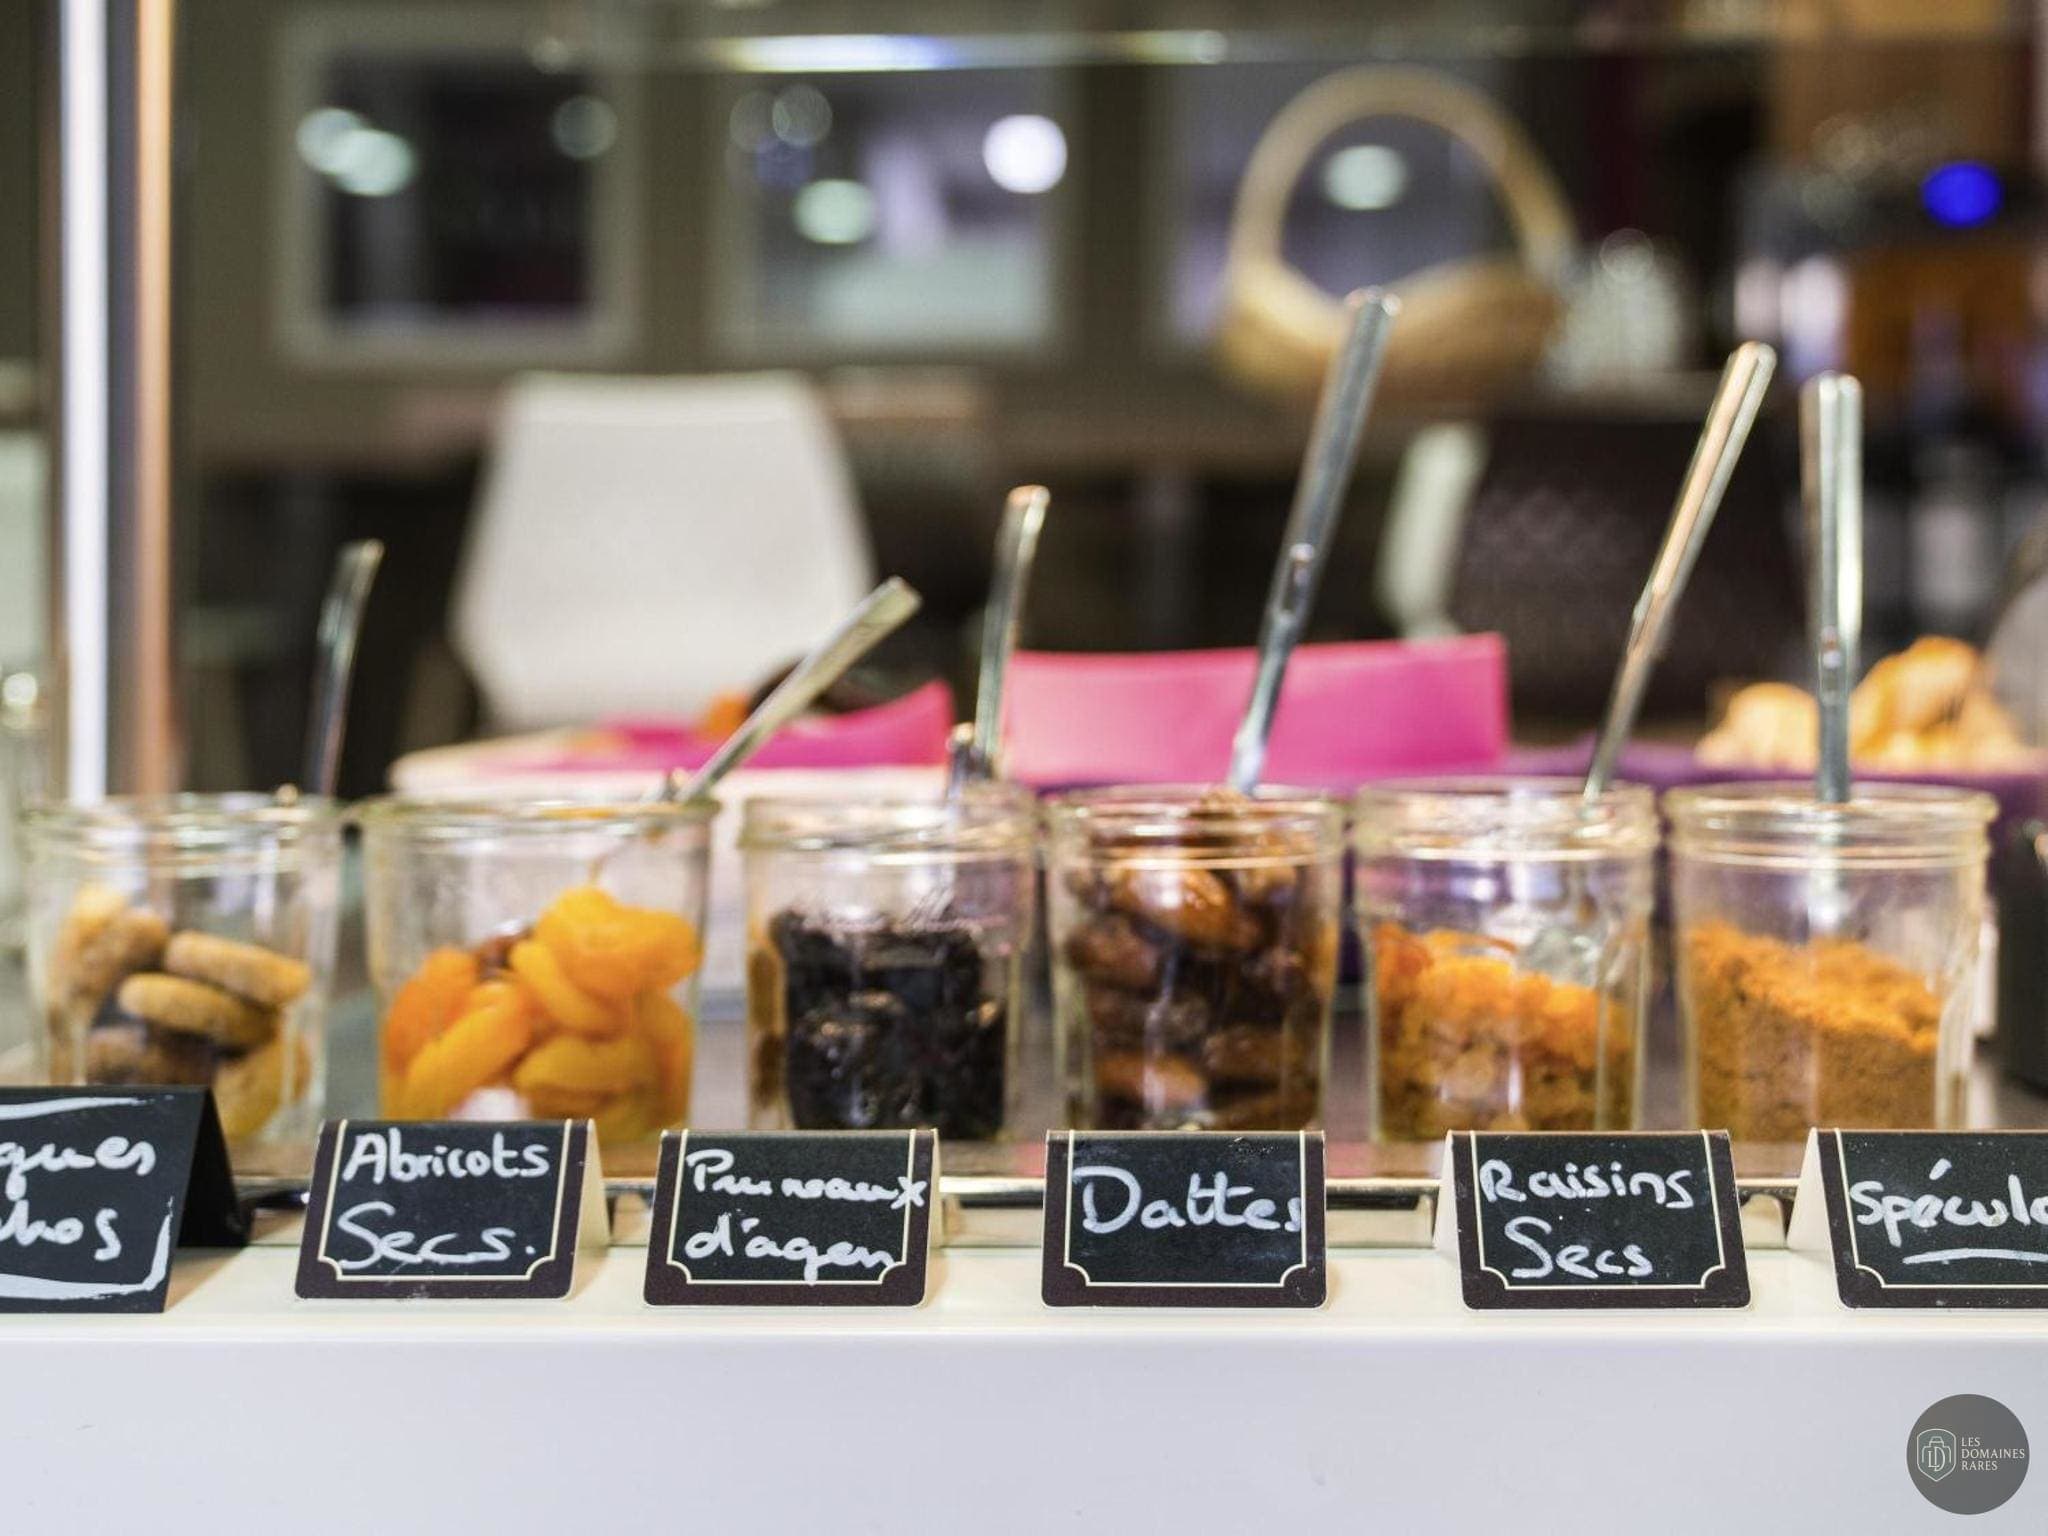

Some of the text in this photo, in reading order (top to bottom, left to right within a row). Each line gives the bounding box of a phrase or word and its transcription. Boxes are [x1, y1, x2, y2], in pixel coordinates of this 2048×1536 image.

[341, 1126, 551, 1184] Abricots
[1478, 1158, 1695, 1210] Raisins
[1071, 1164, 1302, 1233] Dattes
[1503, 1214, 1654, 1280] Secs
